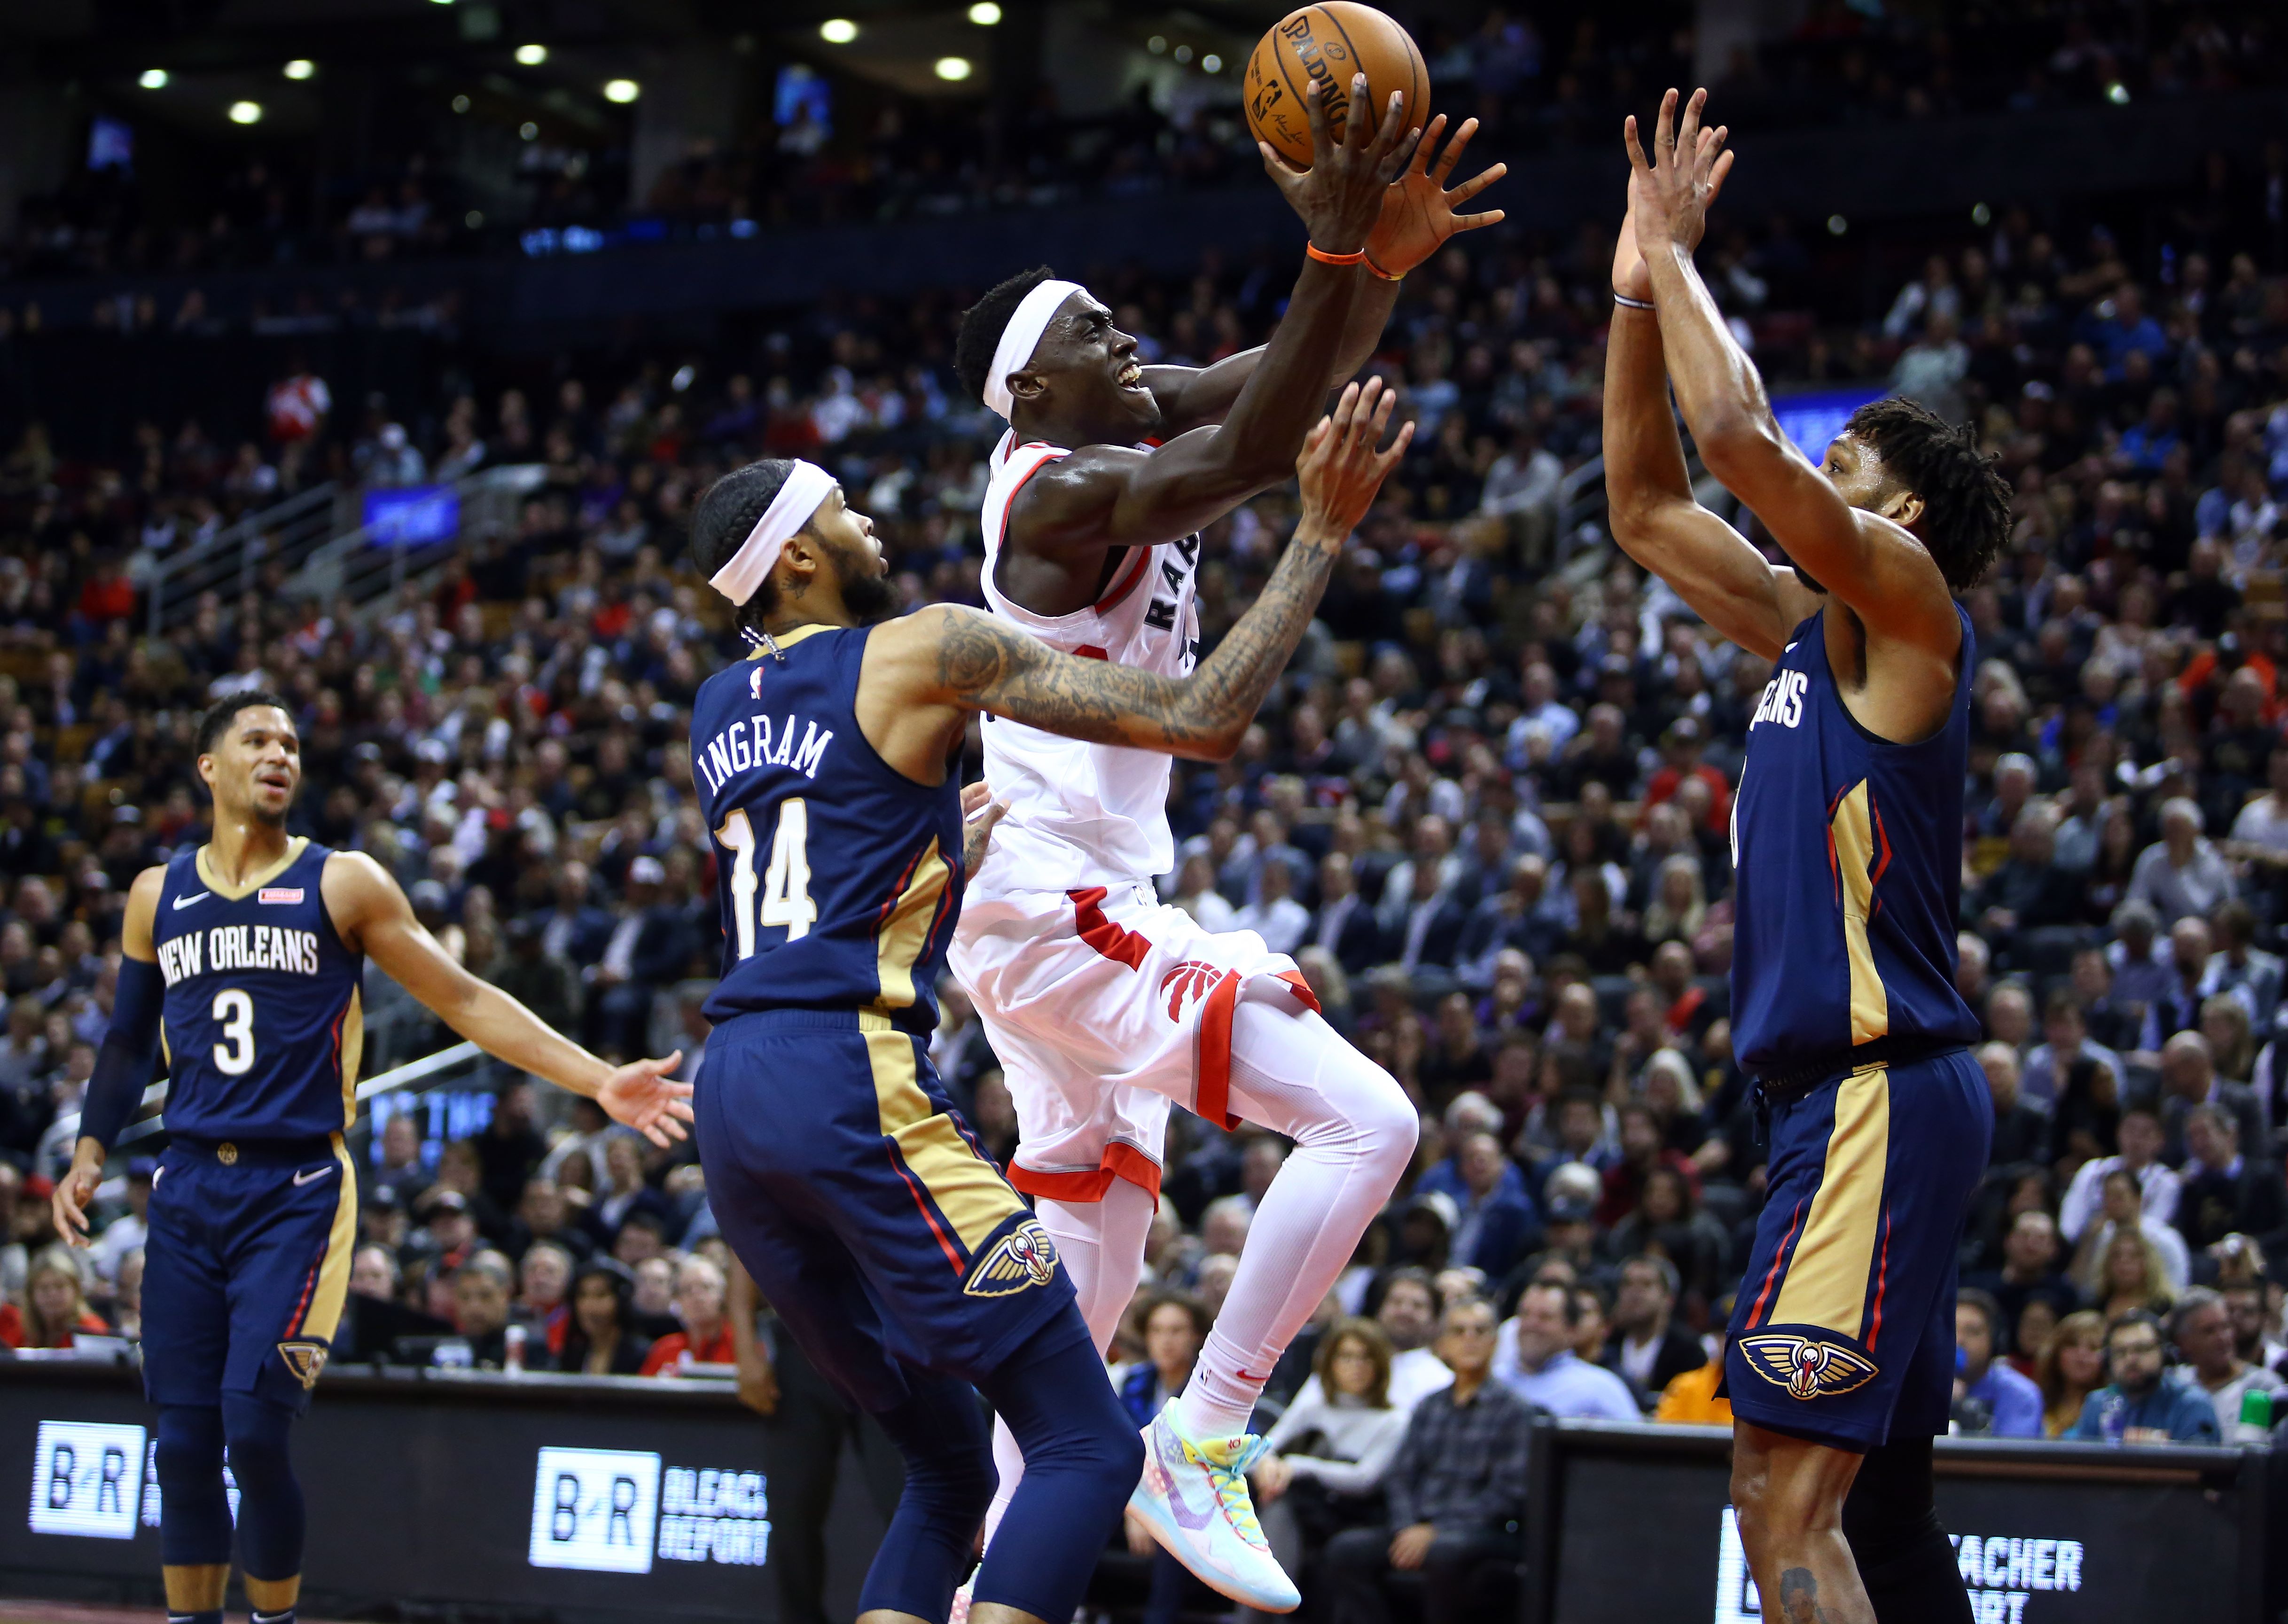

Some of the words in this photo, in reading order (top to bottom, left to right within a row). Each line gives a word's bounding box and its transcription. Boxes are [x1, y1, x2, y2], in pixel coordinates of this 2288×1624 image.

[1281, 15, 1350, 127] SPALDING
[697, 714, 833, 796] INGRAM
[713, 797, 818, 960] 14
[156, 930, 203, 988] NEW
[209, 924, 318, 976] ORLEANS
[212, 987, 255, 1076] 3
[1947, 1534, 2084, 1592] ACHER
